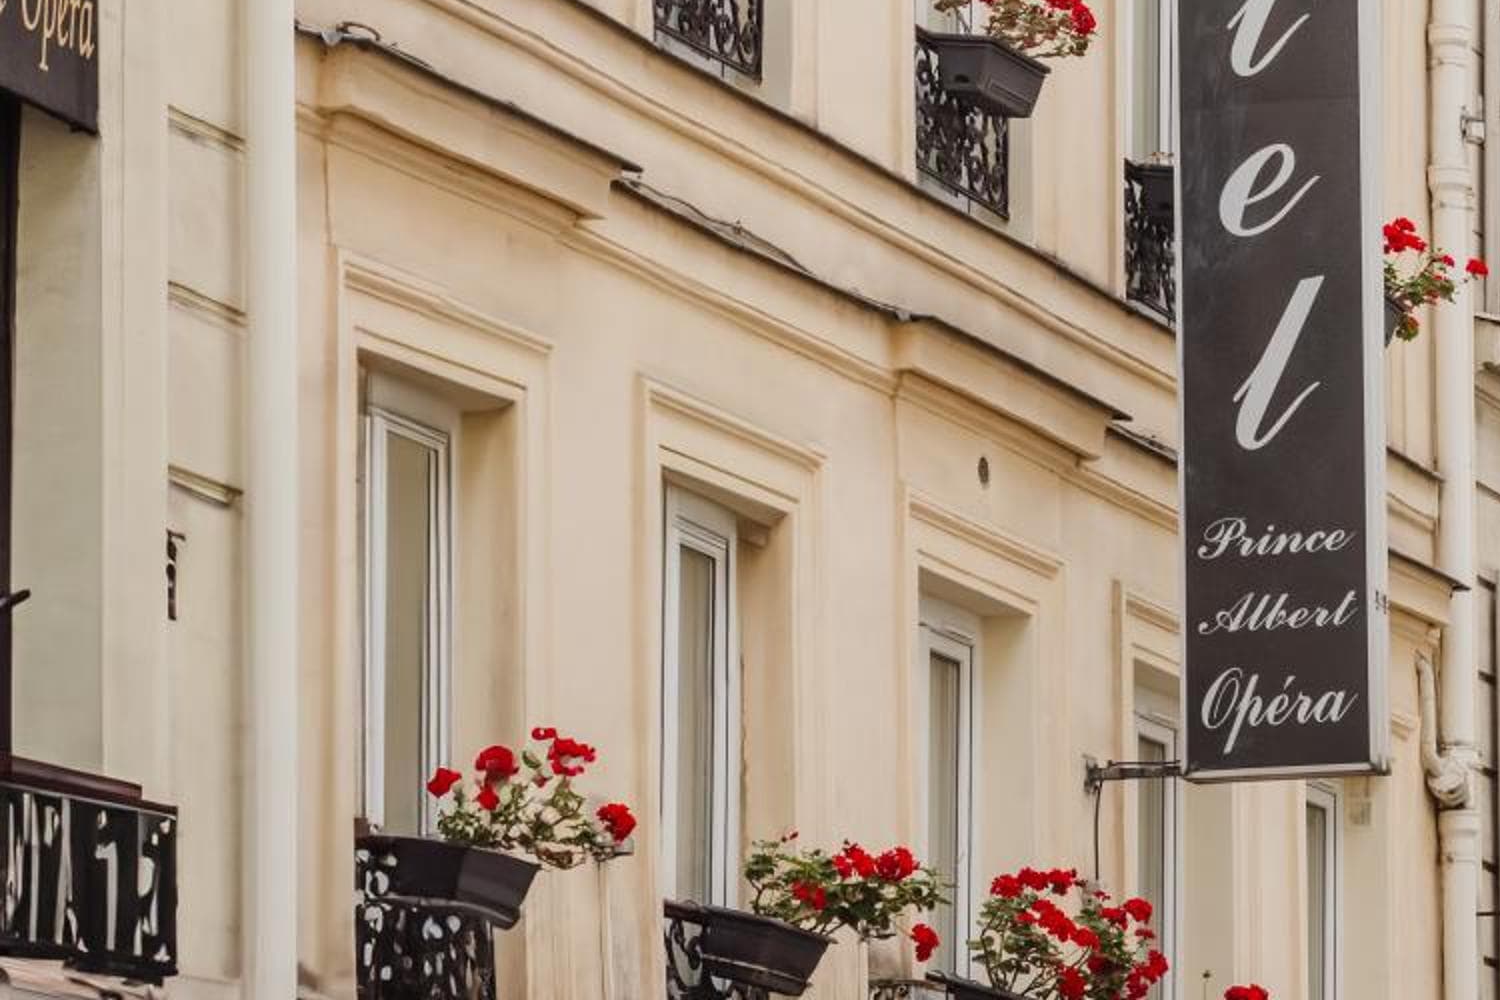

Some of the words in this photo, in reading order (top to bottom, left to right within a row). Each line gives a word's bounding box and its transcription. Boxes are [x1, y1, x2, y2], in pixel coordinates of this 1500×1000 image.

[1197, 517, 1353, 559] Prince
[1198, 590, 1358, 634] Albert
[1201, 667, 1358, 755] Opéra
